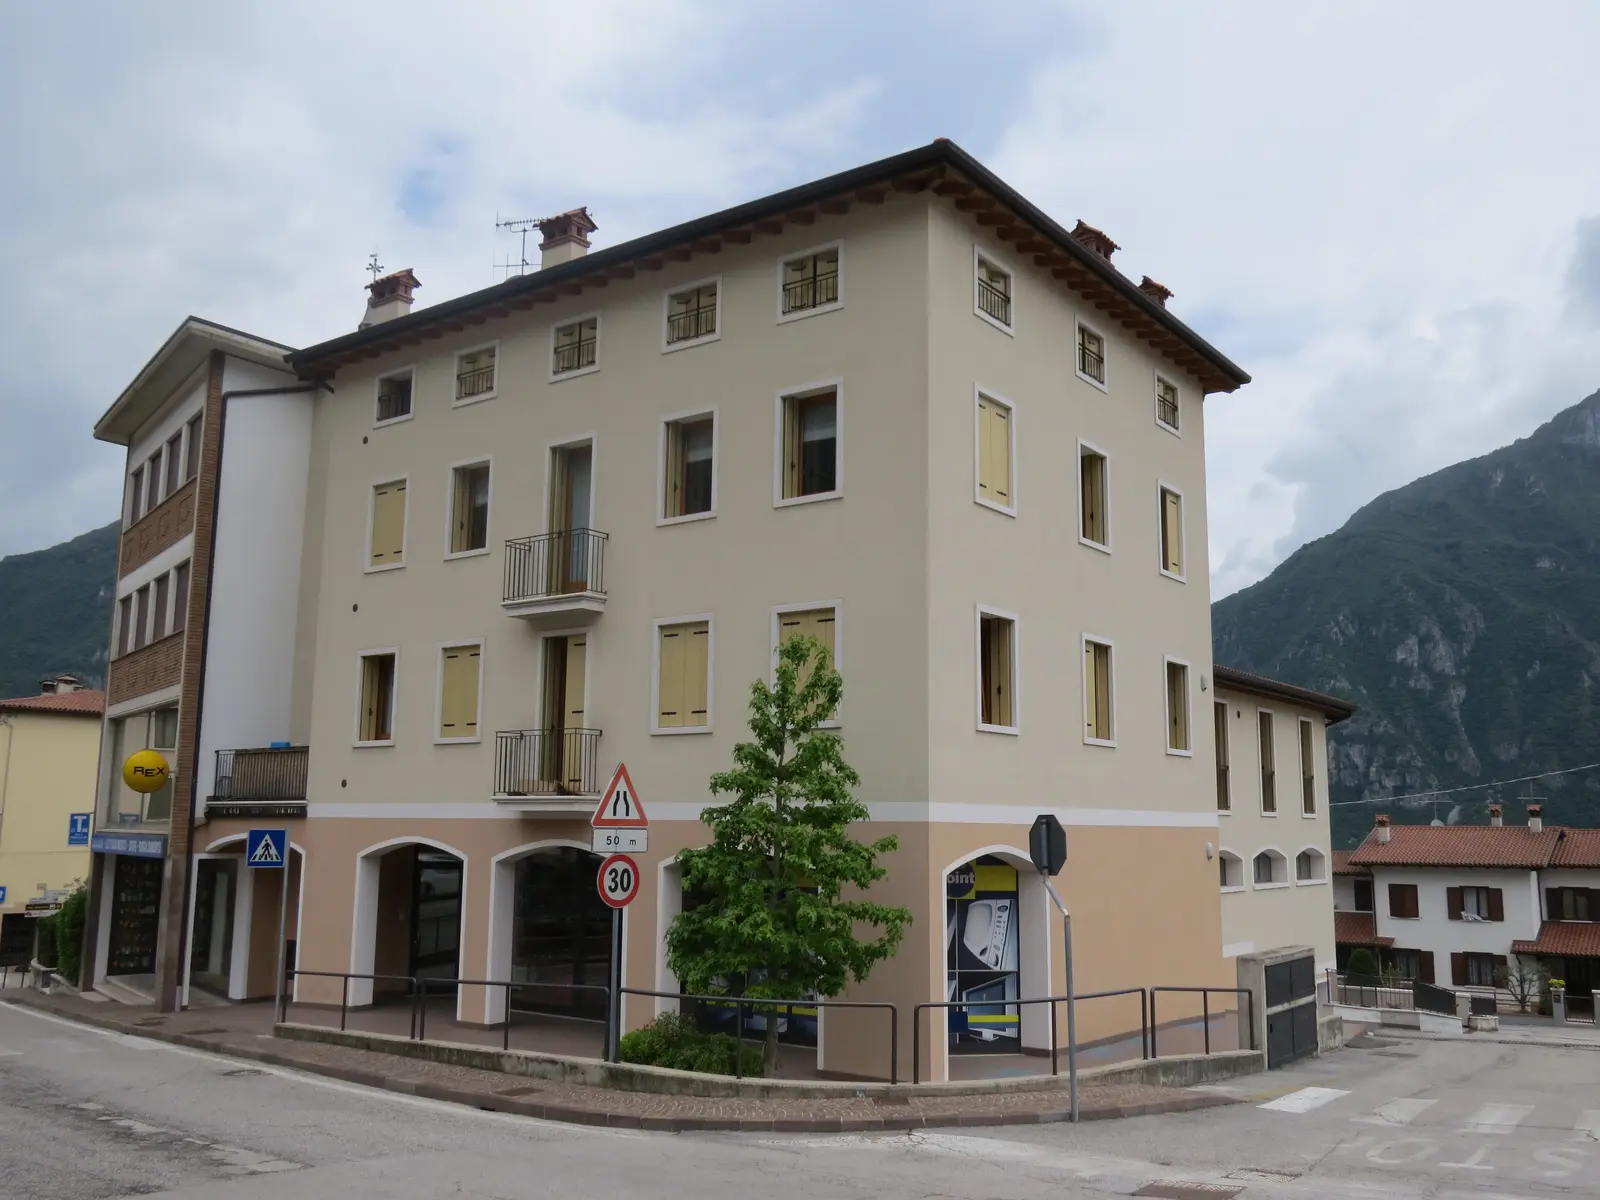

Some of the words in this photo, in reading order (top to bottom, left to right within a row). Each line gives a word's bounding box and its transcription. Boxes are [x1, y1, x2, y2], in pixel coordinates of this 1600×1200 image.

[133, 766, 165, 778] REX
[606, 836, 620, 845] 50
[608, 868, 631, 893] 30
[948, 871, 976, 884] oint
